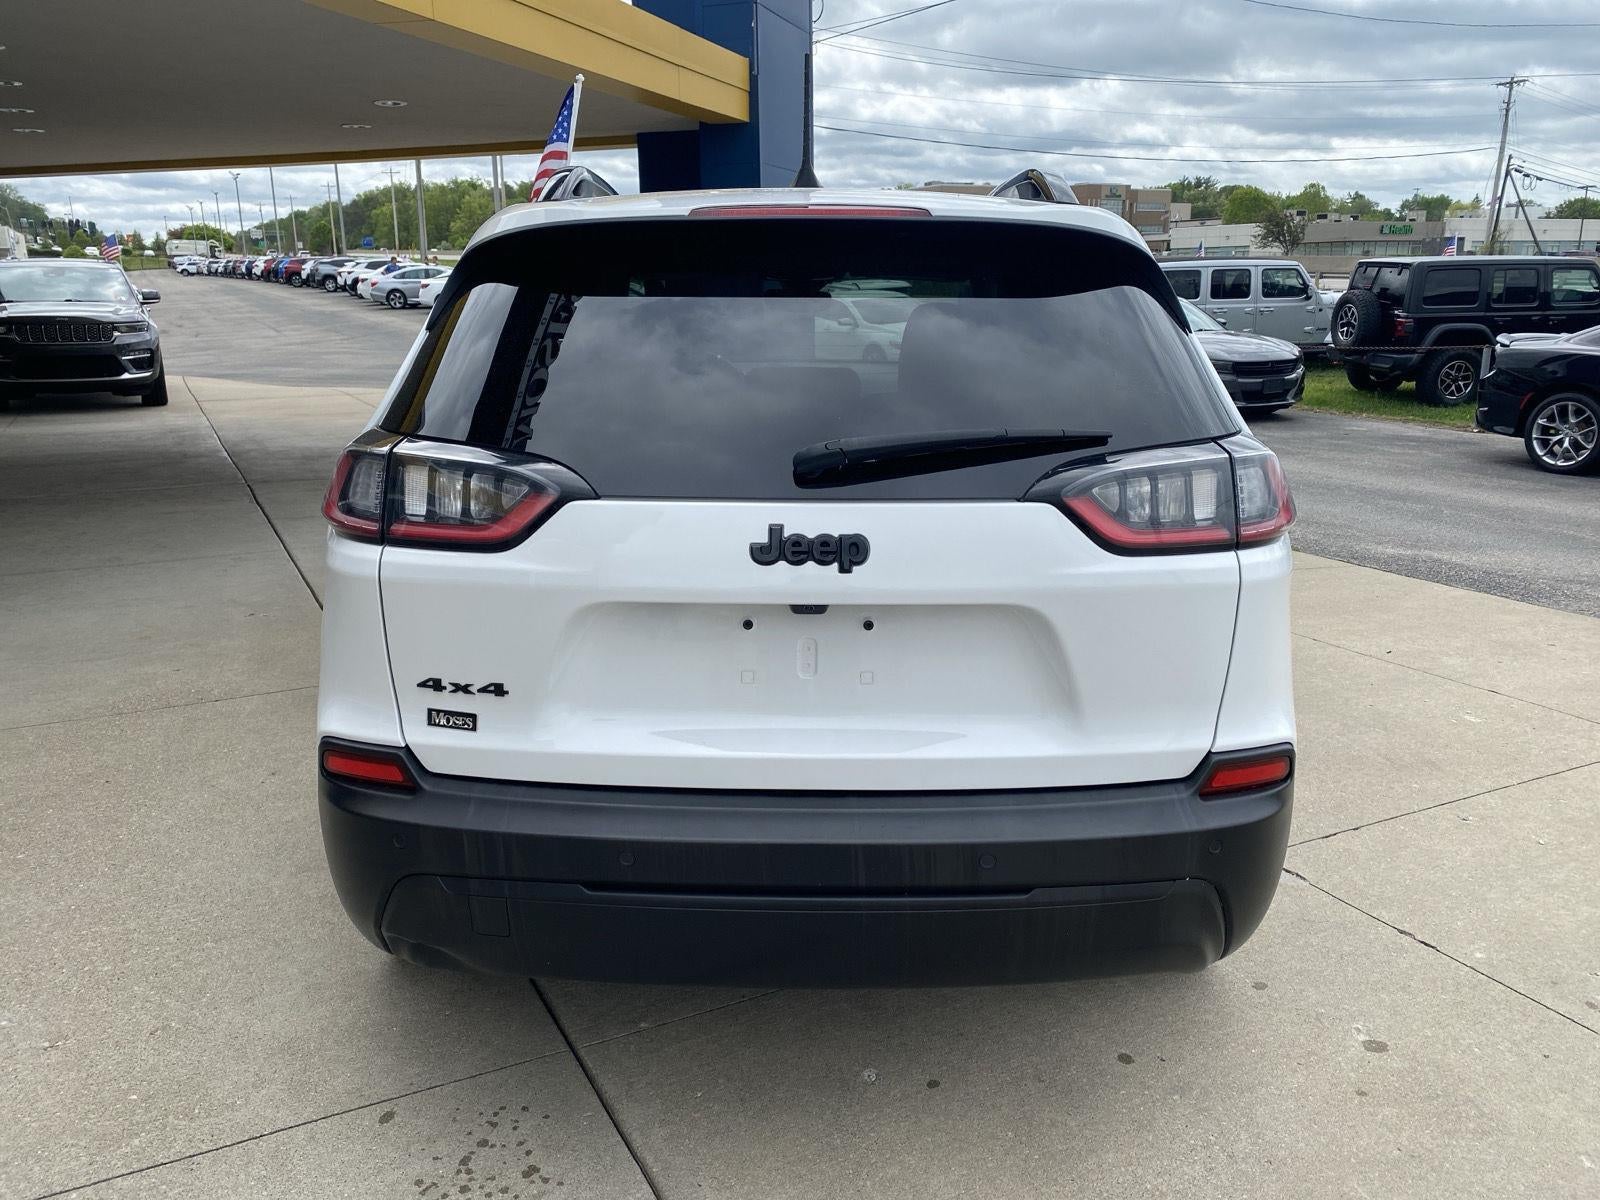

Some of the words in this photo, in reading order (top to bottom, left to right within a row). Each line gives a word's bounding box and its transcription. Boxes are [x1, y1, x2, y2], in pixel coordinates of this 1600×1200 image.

[749, 523, 871, 574] Jeep
[416, 677, 510, 698] 4x4
[431, 711, 473, 729] MOSES
